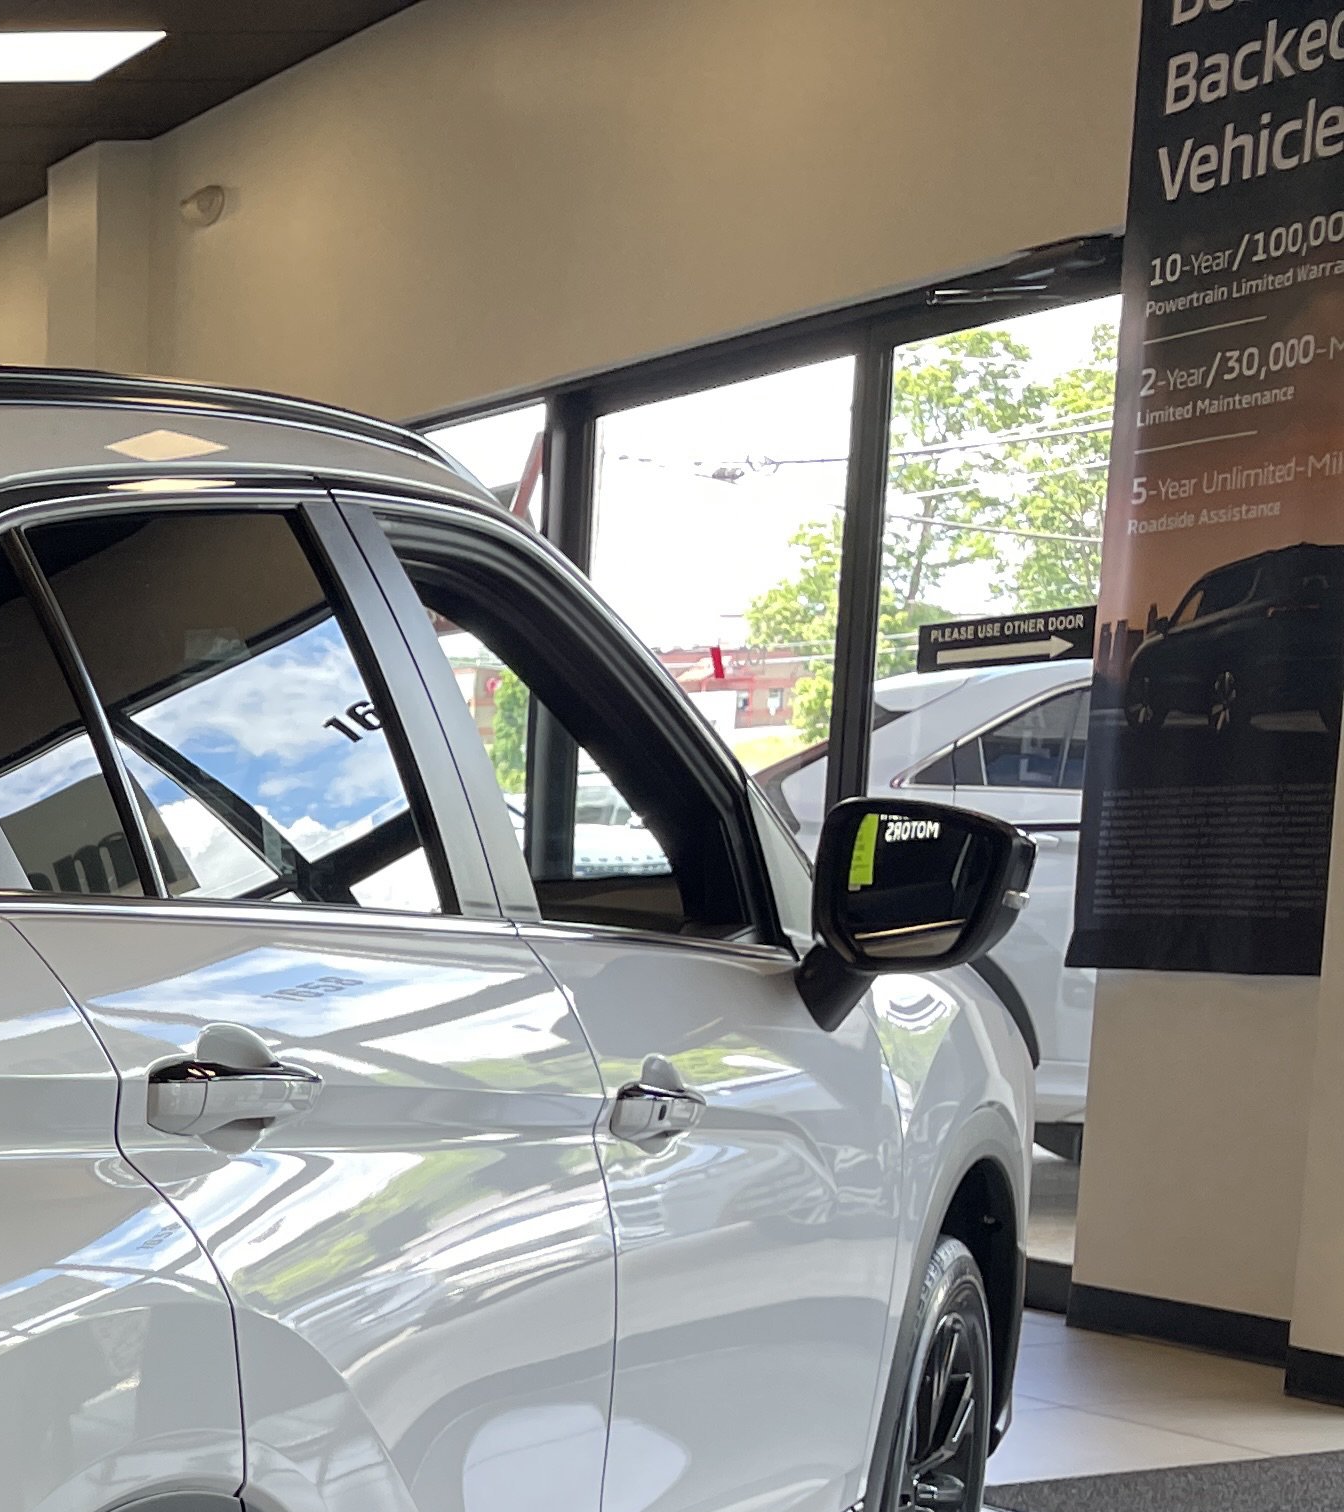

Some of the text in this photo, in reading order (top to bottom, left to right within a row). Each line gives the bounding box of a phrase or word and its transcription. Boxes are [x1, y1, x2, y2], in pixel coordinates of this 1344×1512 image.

[1158, 97, 1344, 201] Vehicle
[1145, 284, 1229, 318] Powertrain
[1231, 267, 1294, 299] Limited
[1136, 385, 1295, 428] Limited Maintenance
[1130, 475, 1198, 505] 5-Year
[1127, 501, 1281, 536] Roadside Assistance
[930, 614, 1085, 643] PLEASE USE OTHER DOOR
